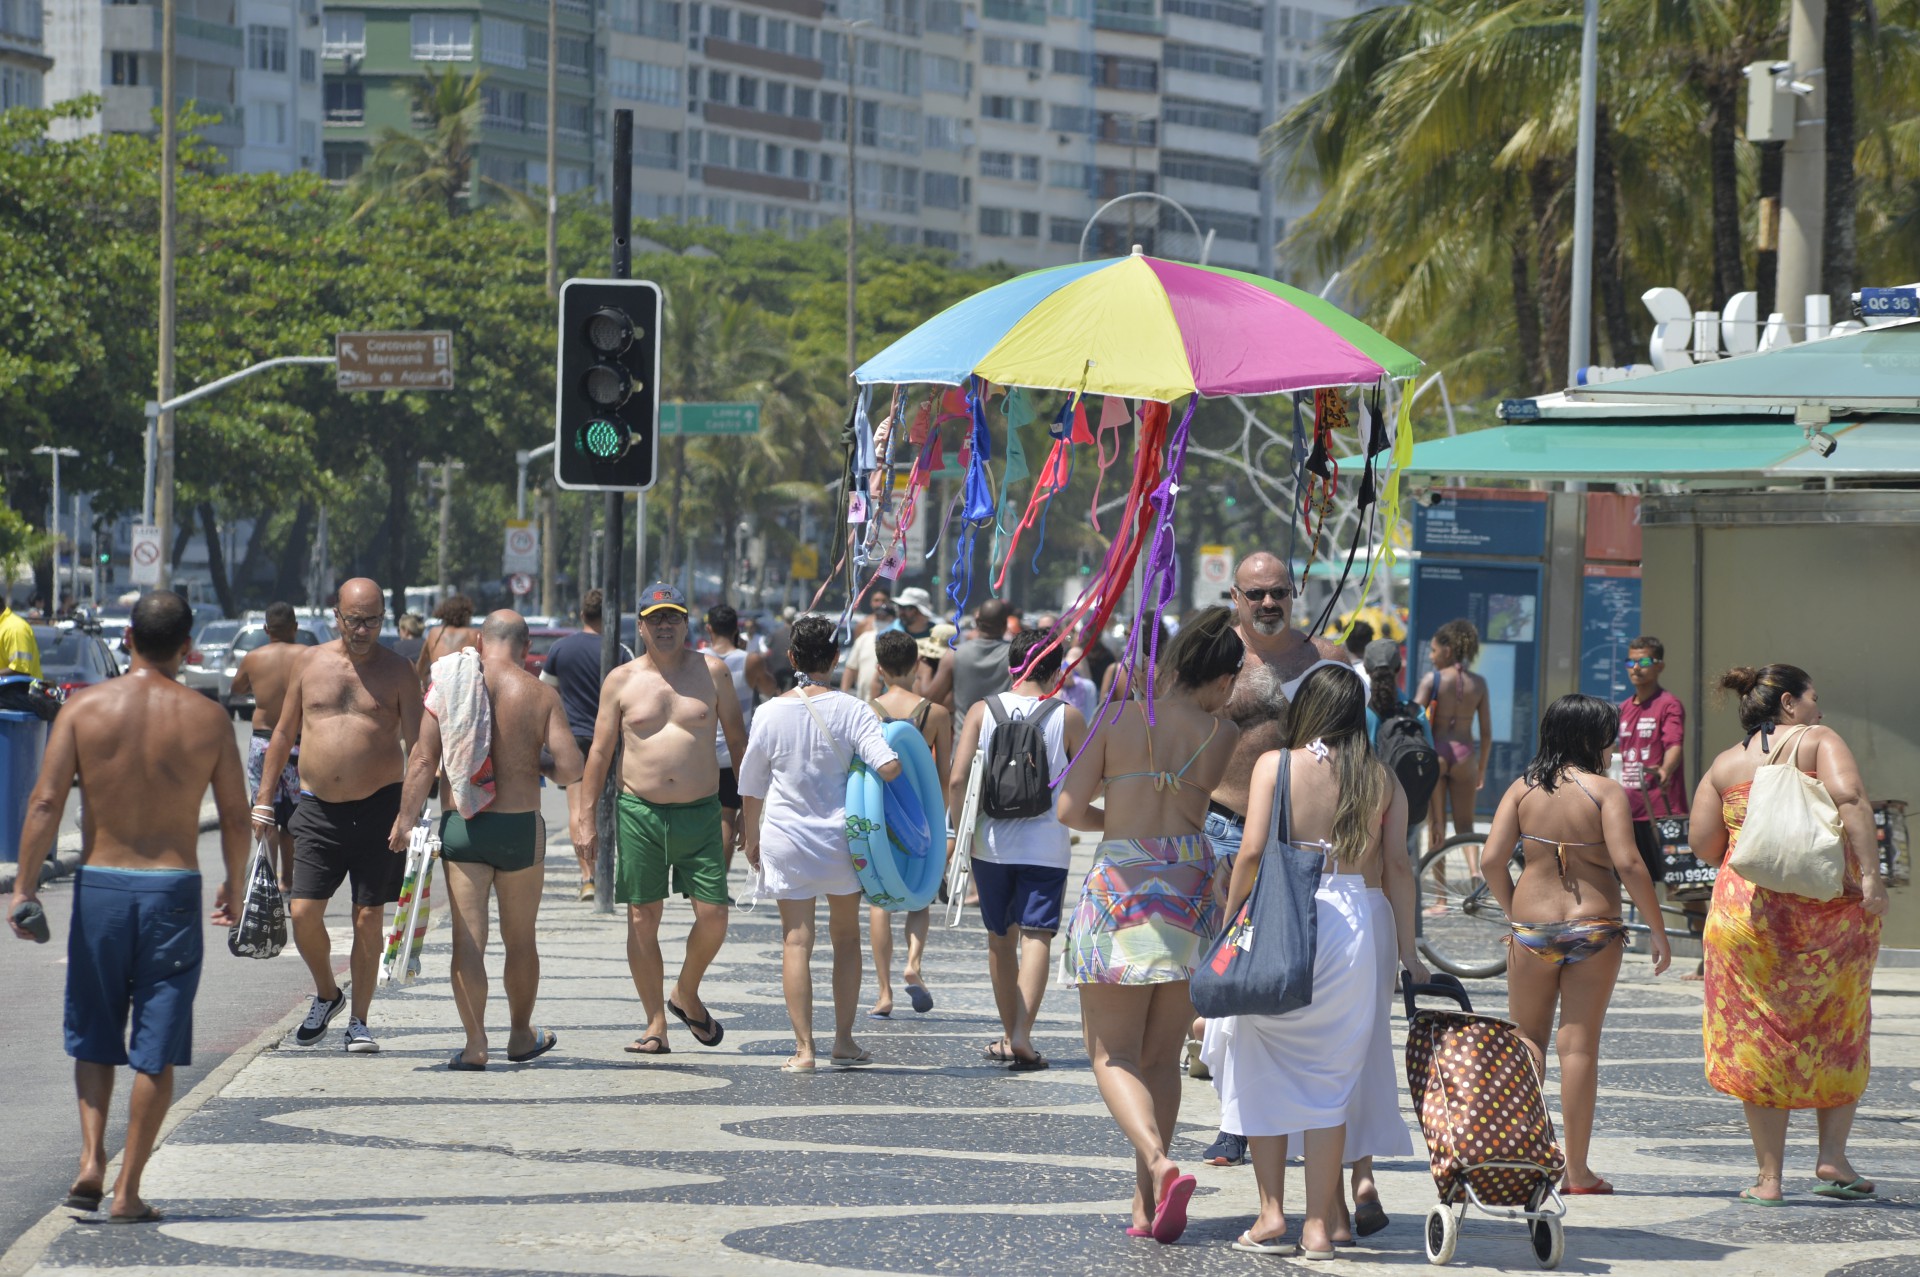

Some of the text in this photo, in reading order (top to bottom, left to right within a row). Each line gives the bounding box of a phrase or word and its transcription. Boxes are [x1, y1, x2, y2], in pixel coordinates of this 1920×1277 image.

[1868, 297, 1911, 310] QC 36
[366, 339, 428, 352] Corcovado
[379, 371, 394, 383] de
[1685, 868, 1720, 882] 9926
